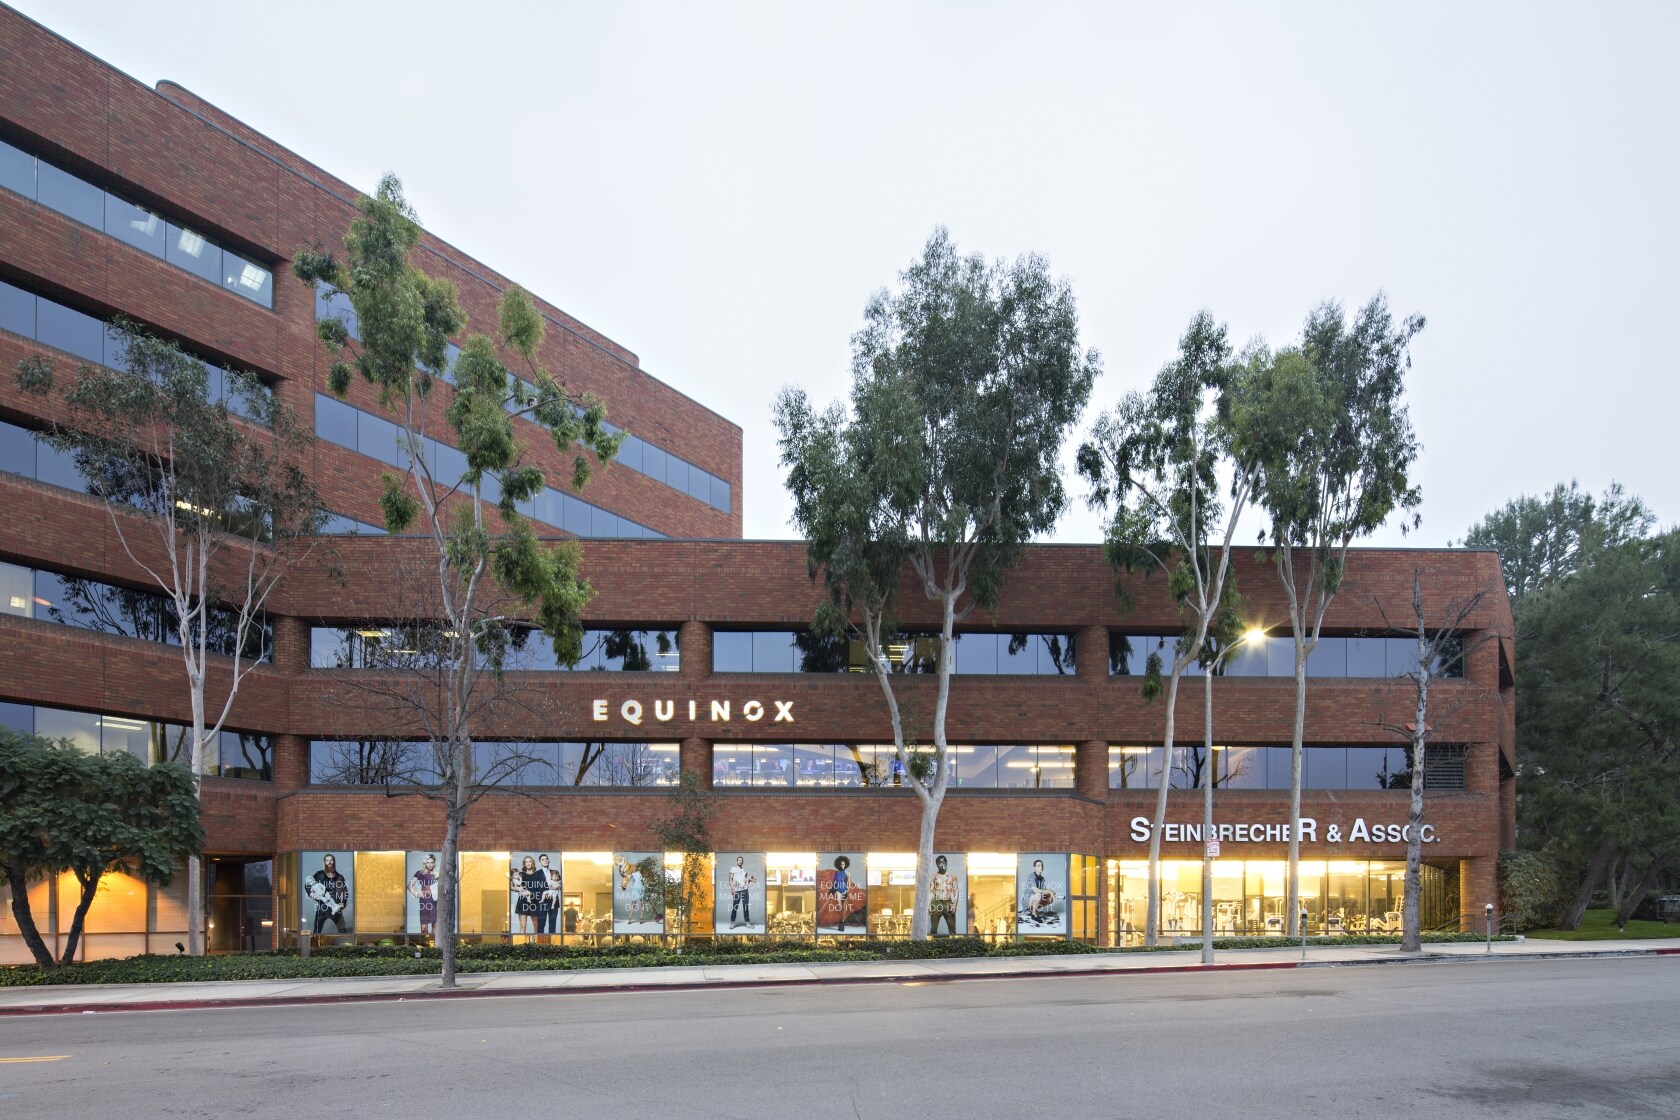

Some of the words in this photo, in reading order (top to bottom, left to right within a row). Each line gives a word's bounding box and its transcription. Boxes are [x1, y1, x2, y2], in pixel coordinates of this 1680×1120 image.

[592, 699, 794, 725] EQUINOX
[1326, 824, 1342, 842] &
[820, 881, 863, 889] EQUINOX
[820, 893, 846, 901] MADE
[849, 893, 863, 901] ME
[522, 904, 537, 912] DO
[625, 904, 640, 912] DO
[727, 904, 742, 912] DO
[828, 904, 843, 912] DO
